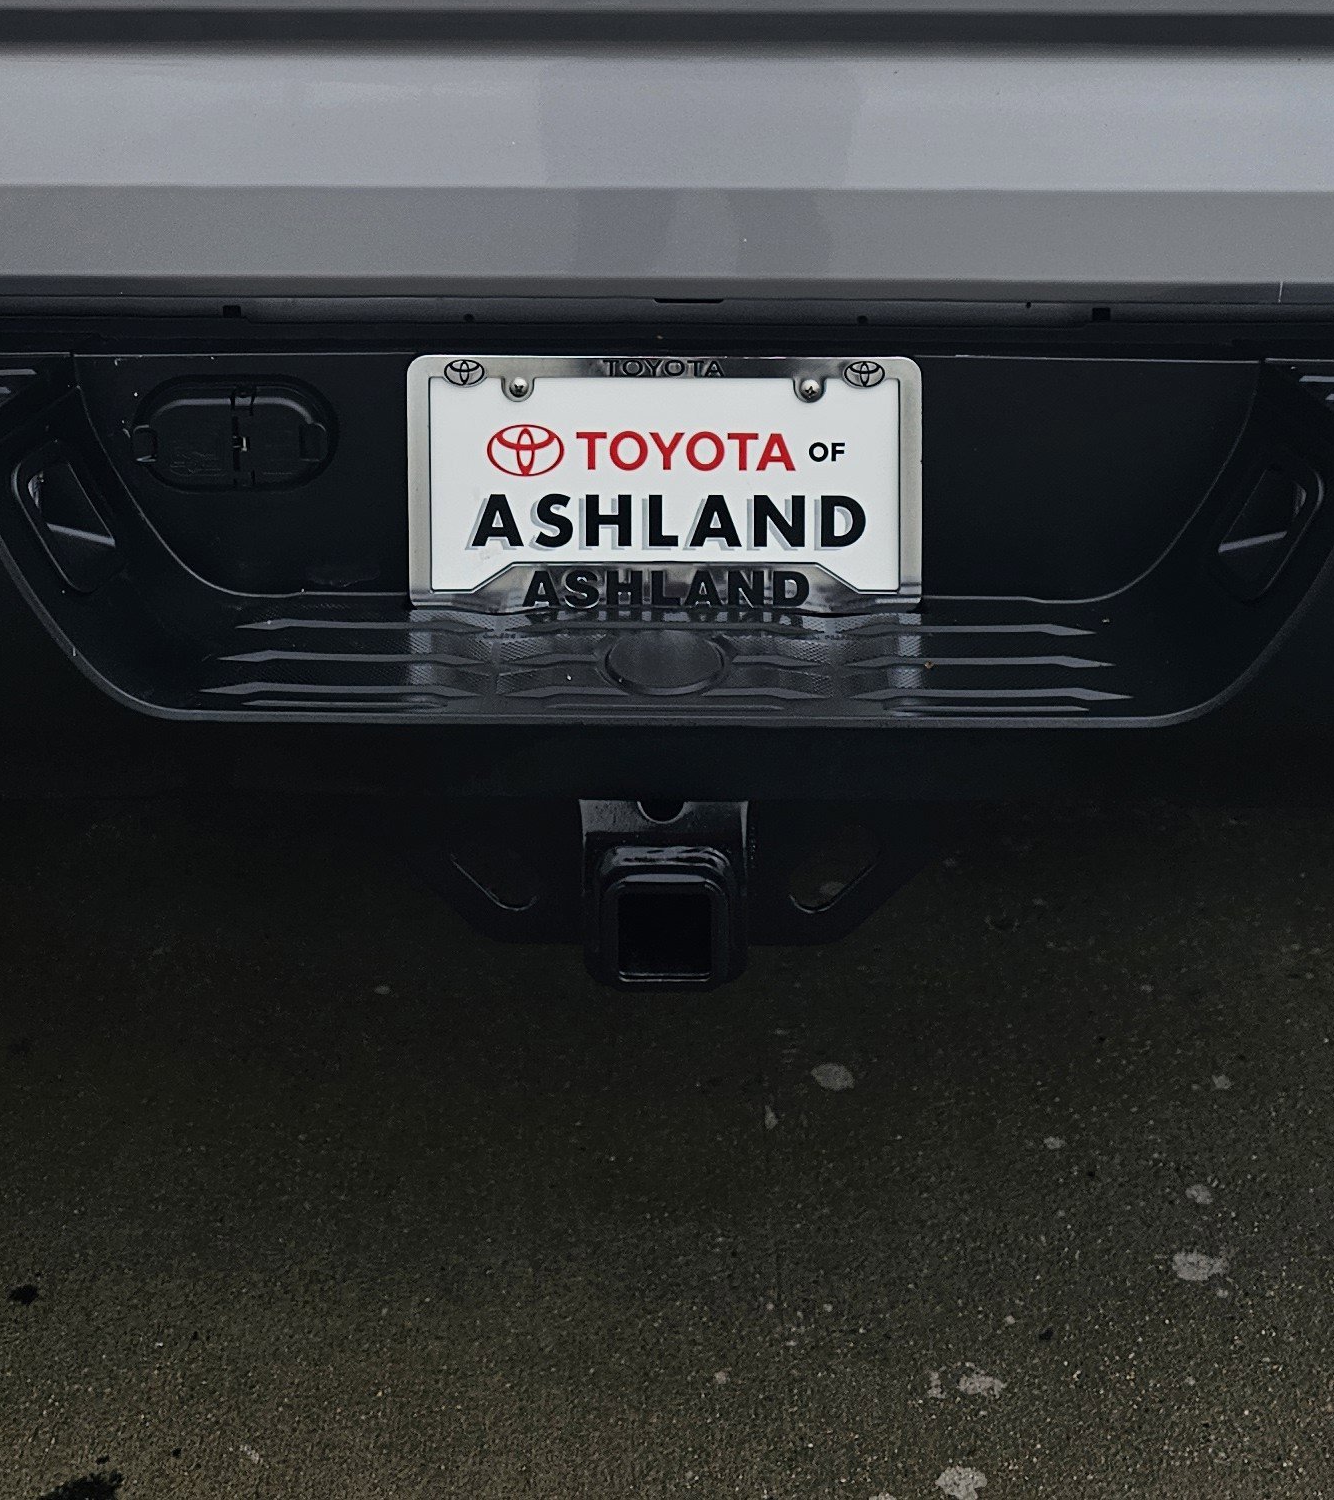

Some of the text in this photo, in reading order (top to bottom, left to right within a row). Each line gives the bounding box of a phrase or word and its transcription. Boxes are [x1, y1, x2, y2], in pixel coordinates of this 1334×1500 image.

[602, 358, 726, 378] TOYOTA
[575, 430, 847, 472] TOYOTA OF
[466, 493, 867, 550] ASHLAND
[521, 569, 811, 609] ASHLAND
